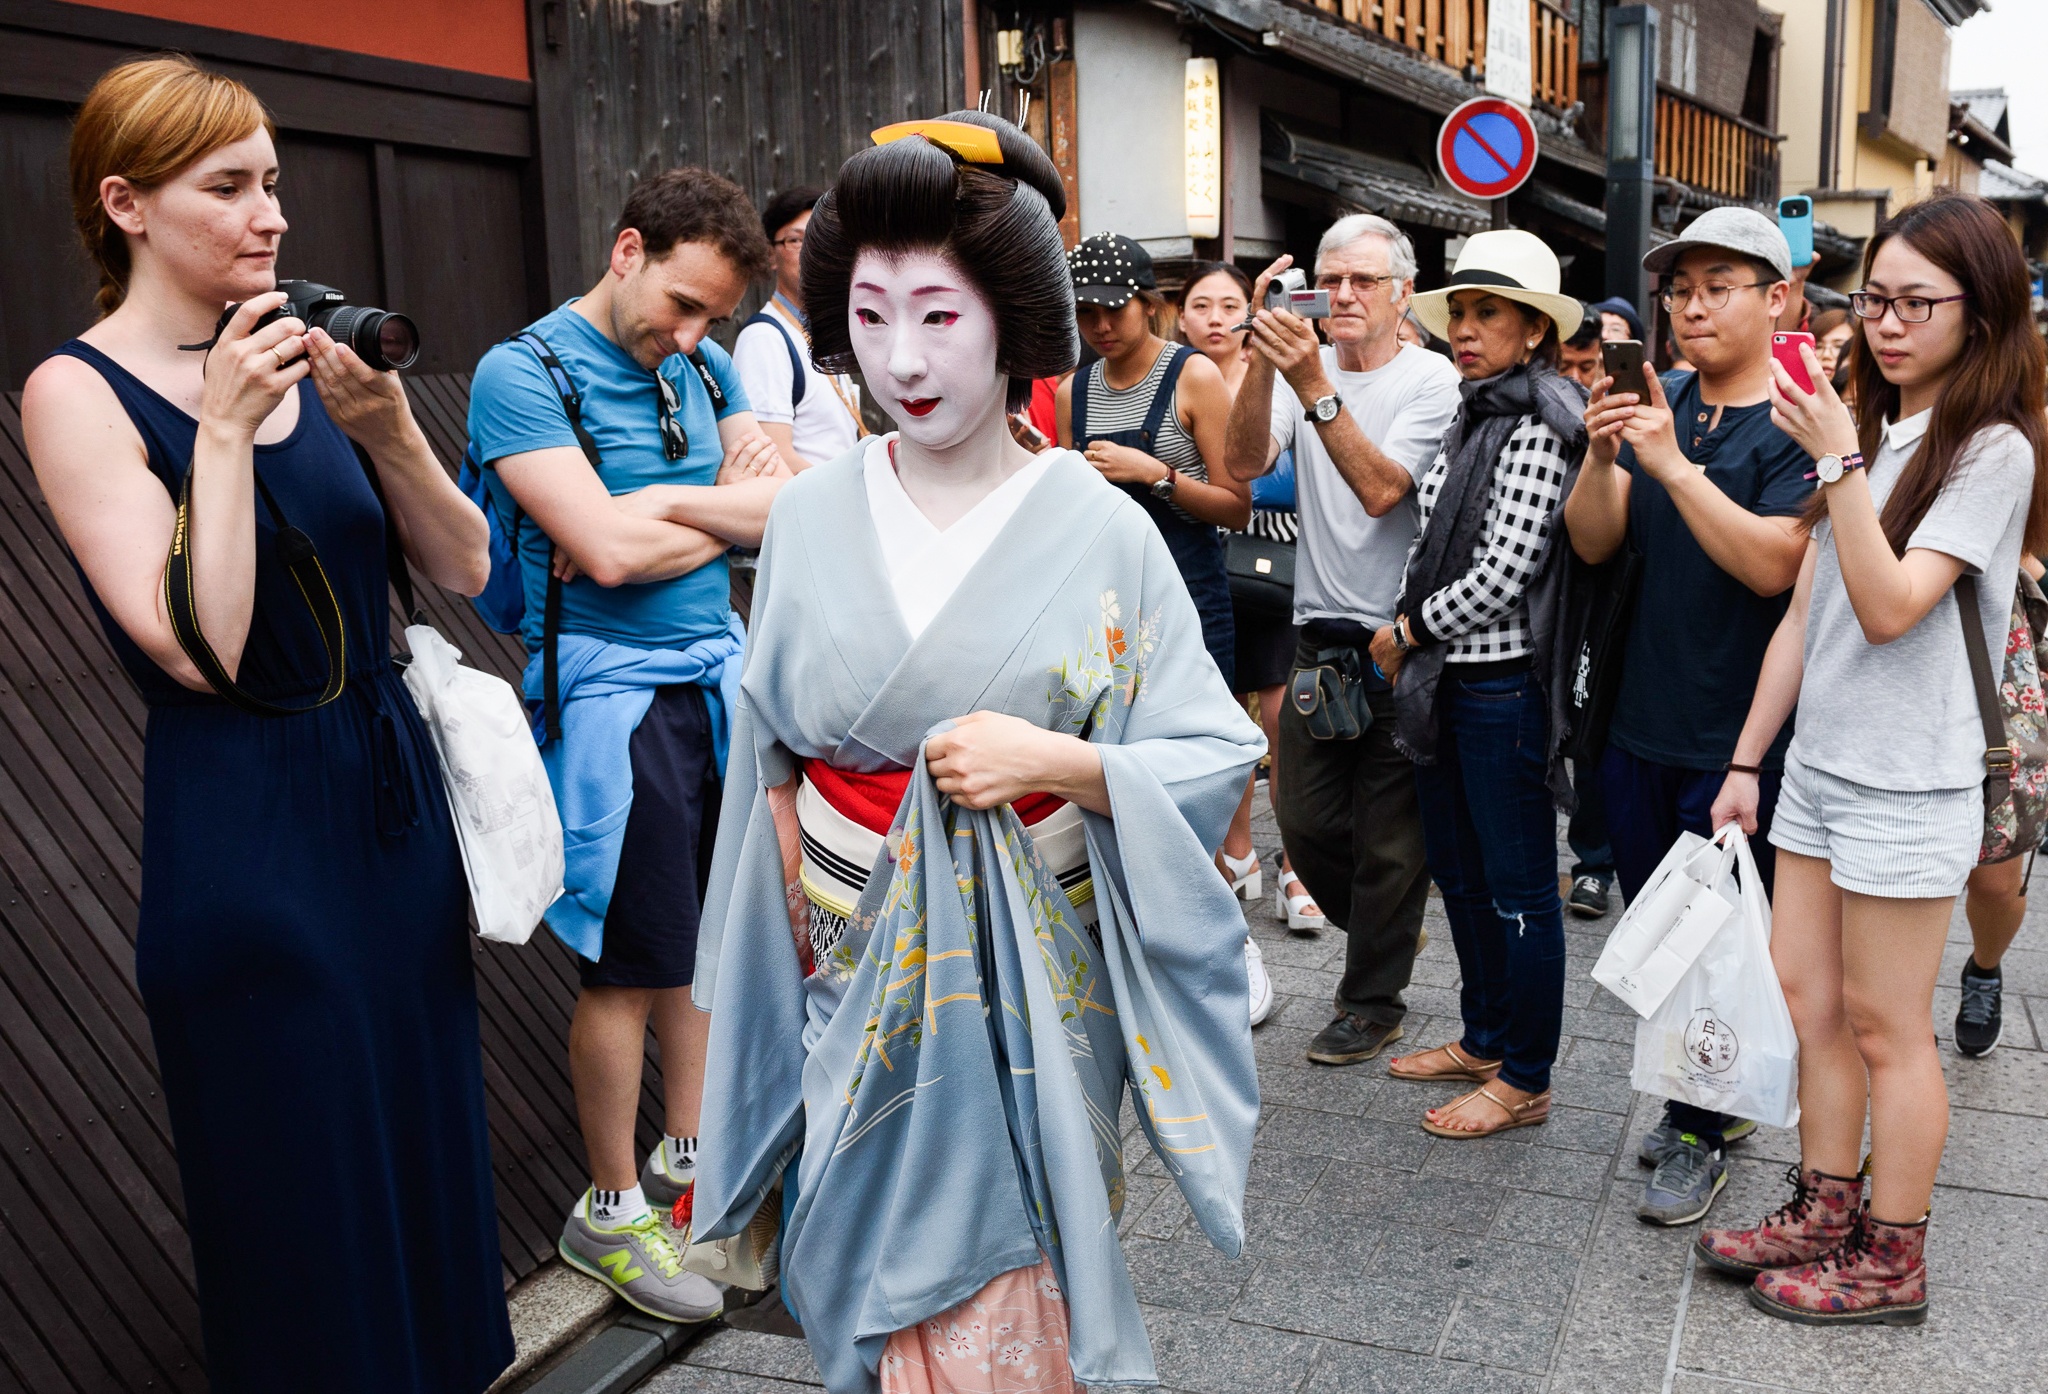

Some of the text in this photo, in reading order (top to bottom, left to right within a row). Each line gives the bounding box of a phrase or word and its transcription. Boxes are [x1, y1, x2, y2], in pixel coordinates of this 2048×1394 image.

[325, 292, 344, 301] Nikon
[174, 503, 186, 556] Nikon
[597, 1247, 644, 1285] N
